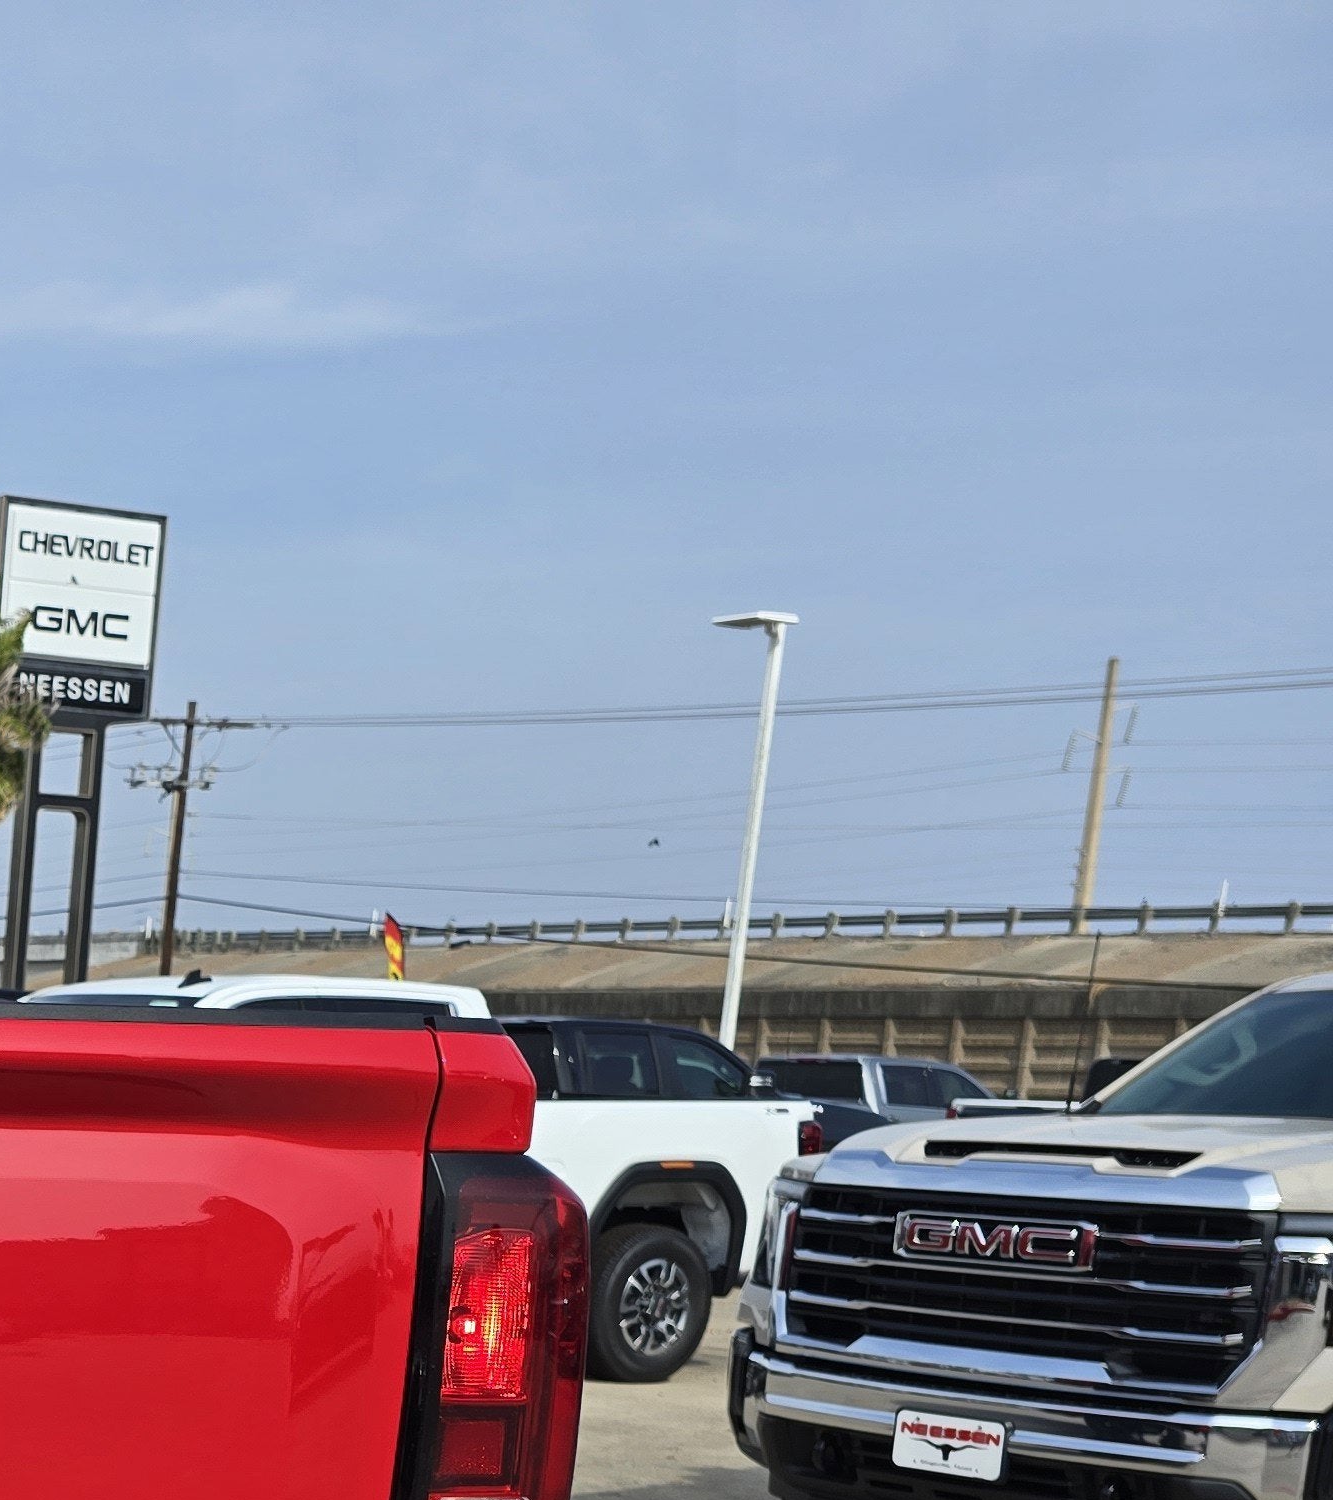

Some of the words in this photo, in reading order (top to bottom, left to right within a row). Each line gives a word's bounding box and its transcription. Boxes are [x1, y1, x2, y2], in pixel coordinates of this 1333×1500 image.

[19, 530, 154, 567] CHEVROLET
[33, 605, 129, 640] GMC
[18, 672, 131, 705] NEESSEN
[904, 1218, 1078, 1264] GMC
